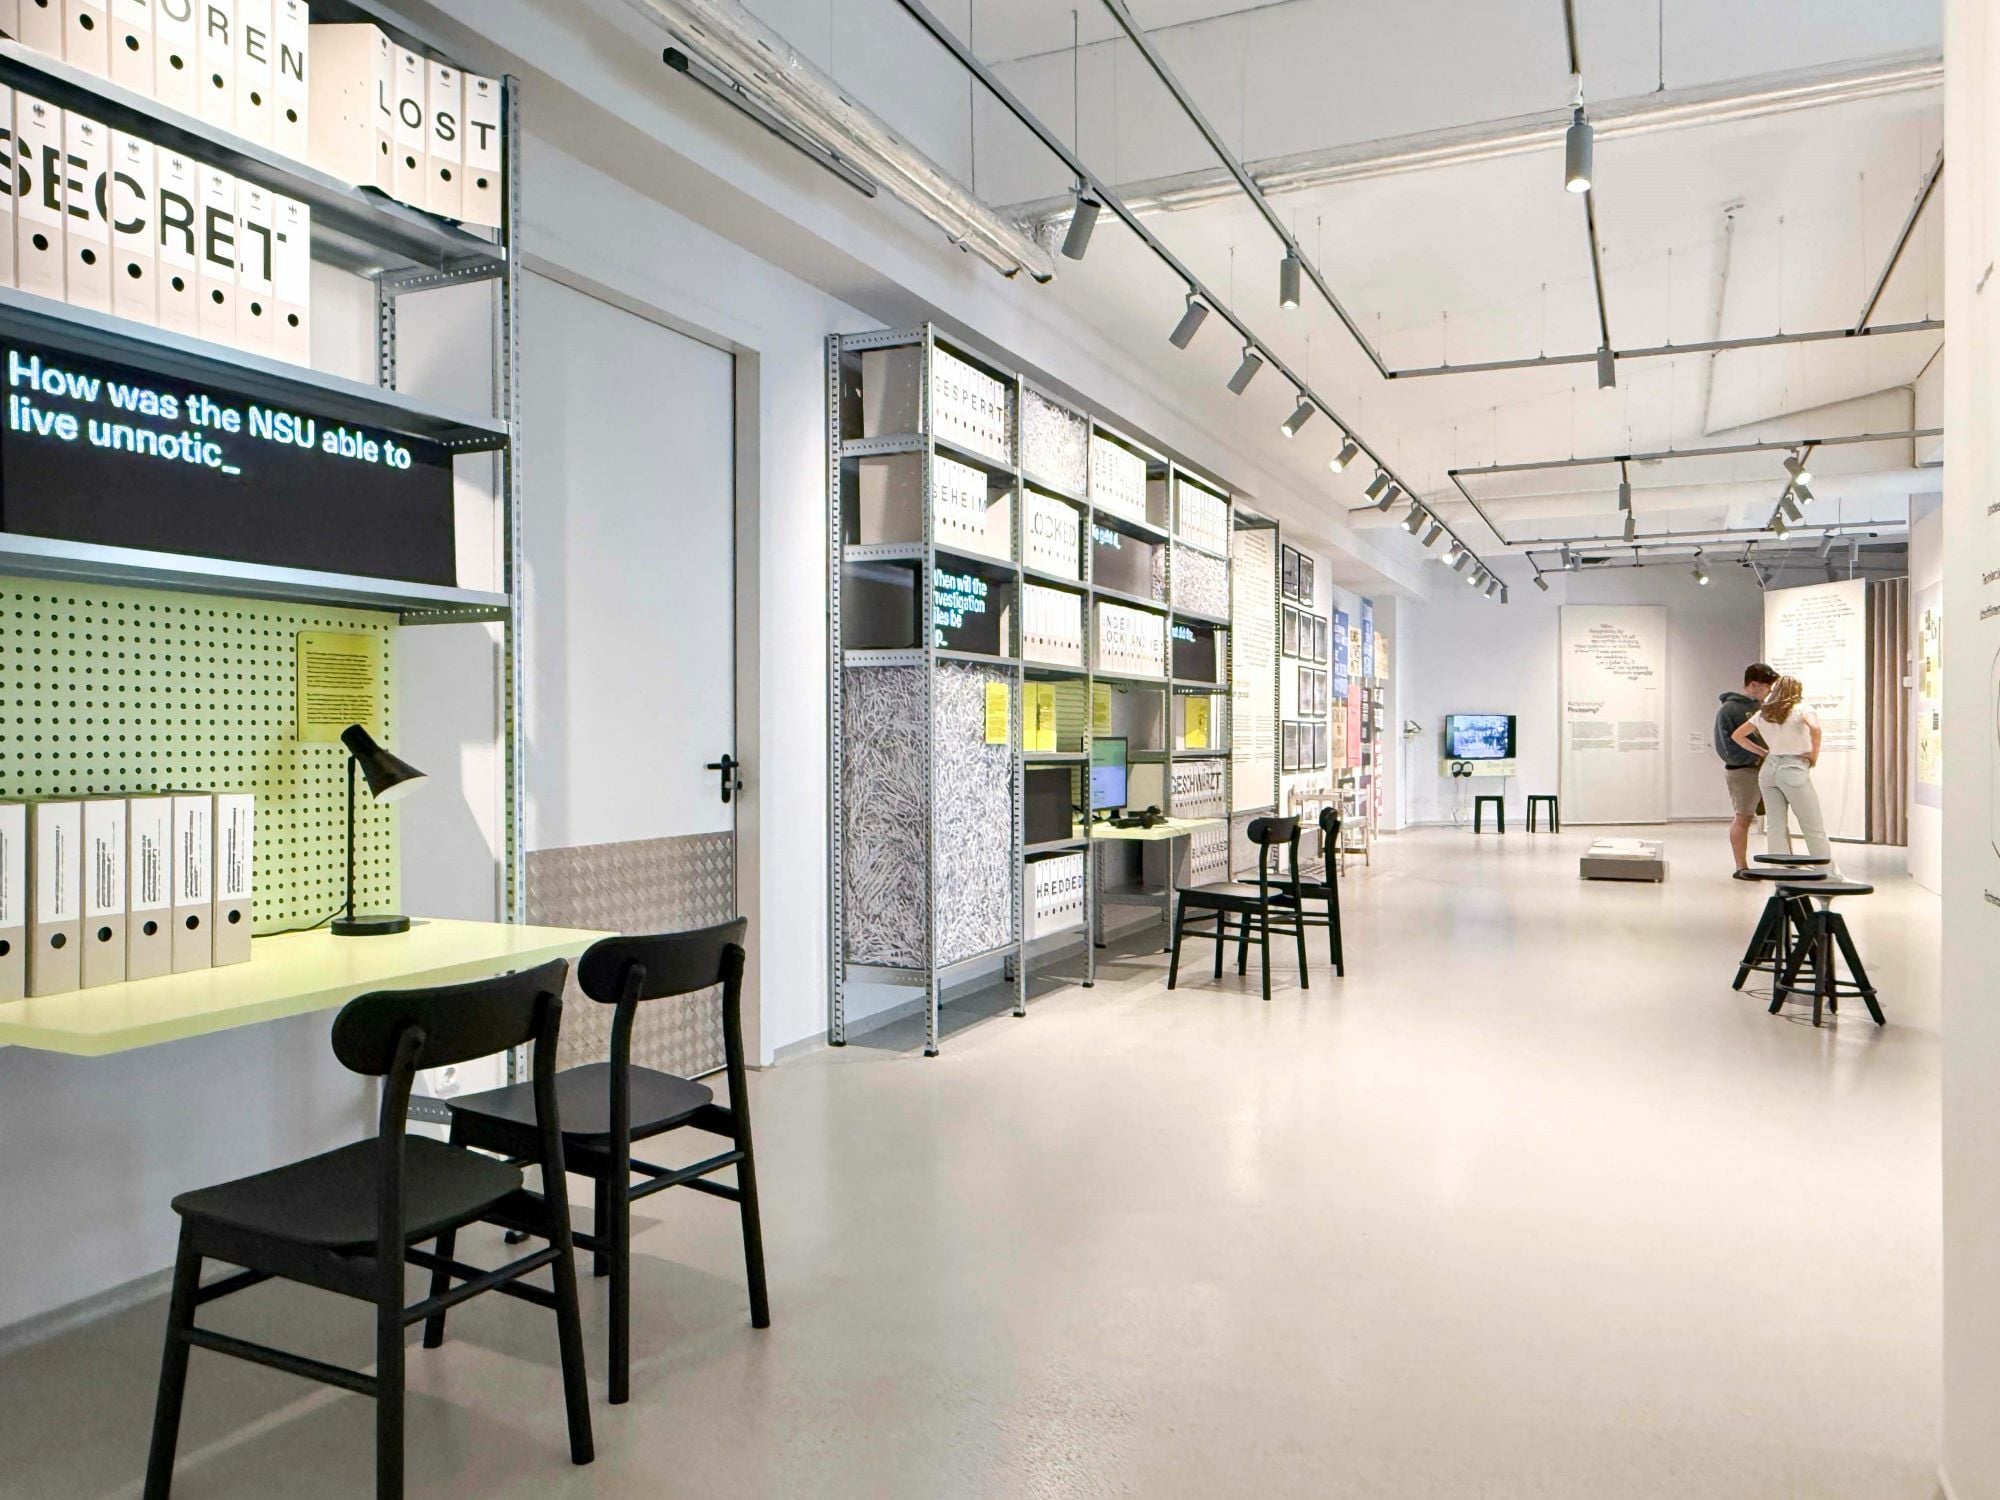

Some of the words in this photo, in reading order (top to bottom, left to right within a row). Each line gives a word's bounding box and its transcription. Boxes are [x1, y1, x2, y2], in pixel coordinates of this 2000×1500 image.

[379, 79, 497, 151] LOST
[0, 127, 287, 282] SECRET
[9, 350, 100, 402] How
[107, 380, 178, 420] was
[185, 394, 241, 433] the
[248, 405, 316, 449] NSU
[322, 427, 379, 464] able
[384, 440, 412, 470] to
[9, 395, 78, 441] live
[935, 375, 1003, 423] GESPERRT
[972, 577, 988, 597] the
[950, 609, 963, 628] be
